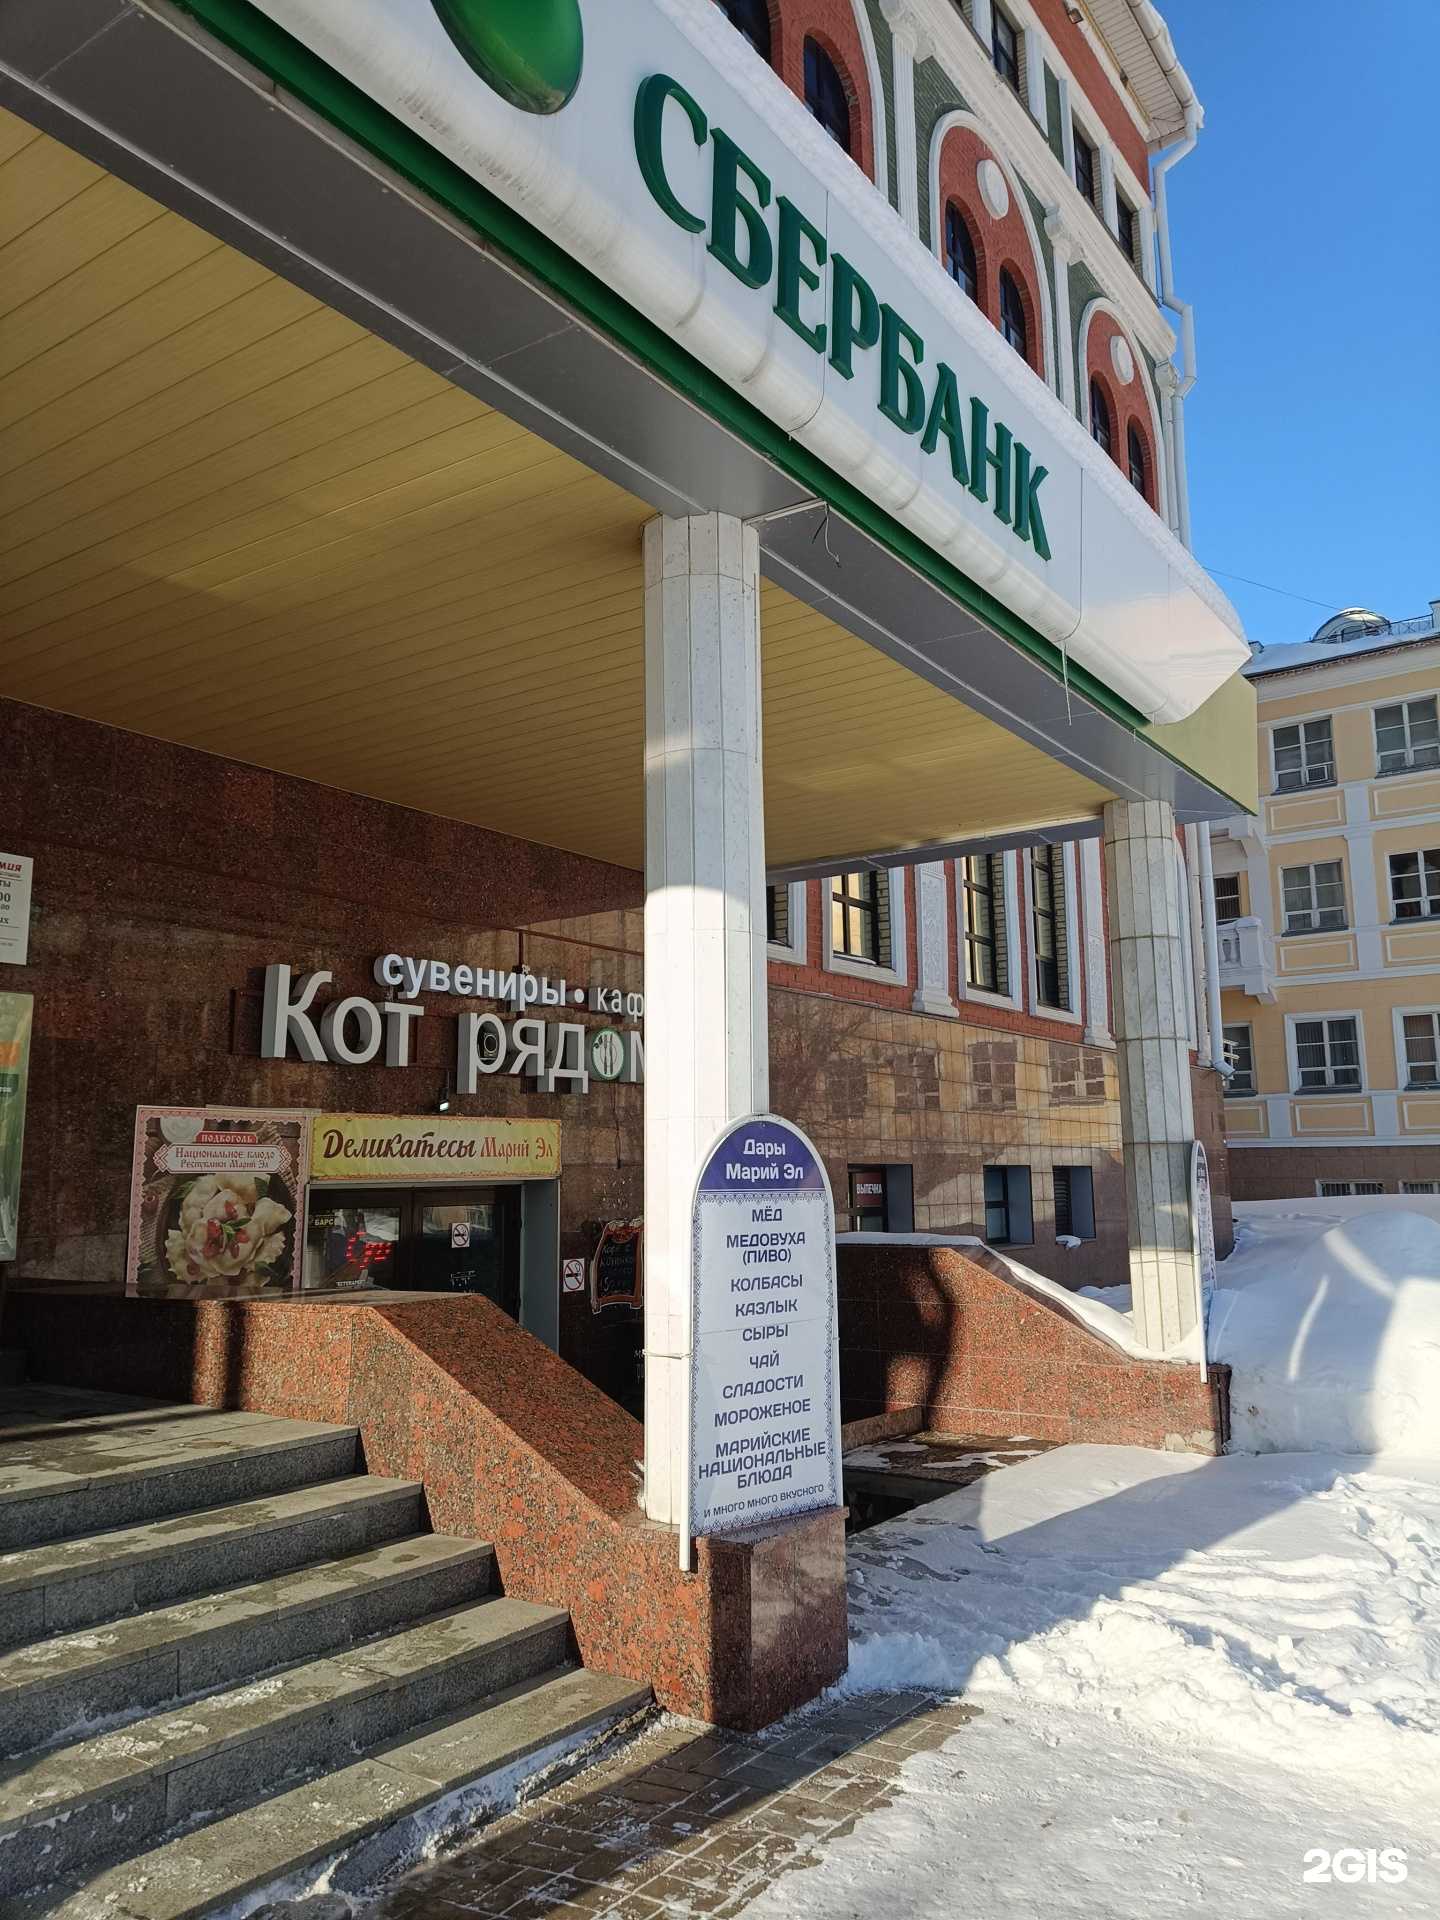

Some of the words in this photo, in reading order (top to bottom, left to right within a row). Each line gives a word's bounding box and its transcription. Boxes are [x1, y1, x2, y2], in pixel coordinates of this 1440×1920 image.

[633, 72, 1051, 562] СБЕРБАНК
[376, 953, 566, 1011] сувениры
[595, 986, 644, 1023] каф
[263, 963, 425, 1067] Кот
[175, 1147, 243, 1160] Национальное
[323, 1128, 477, 1159] Деликатесы
[480, 1135, 530, 1164] Марий
[535, 1136, 553, 1160] Эл
[743, 1138, 786, 1158] Дары
[726, 1162, 779, 1183] Марий
[783, 1163, 804, 1179] Эл
[856, 1183, 882, 1195] ВЫПЕЧКА
[751, 1206, 783, 1222] МЁД
[727, 1231, 806, 1248] МЕДОВУХА
[742, 1248, 792, 1266] (ПИВО)
[731, 1274, 803, 1292] КОЛБАСЫ
[735, 1299, 798, 1317] КАЗЛЫК
[742, 1324, 788, 1341] СЫРЫ
[750, 1350, 780, 1369] ЧАЙ
[722, 1374, 804, 1399] СЛАДОСТИ
[714, 1398, 811, 1428] МОРОЖЕНОЕ
[715, 1427, 811, 1458] МАРИЙСКИЕ
[698, 1441, 827, 1479] НАЦИОНАЛЬНЫЕ
[737, 1465, 793, 1489] БЛЮДА
[713, 1502, 745, 1516] МНОГО
[747, 1494, 778, 1509] МНОГО
[780, 1484, 824, 1500] ВКУСНОГО
